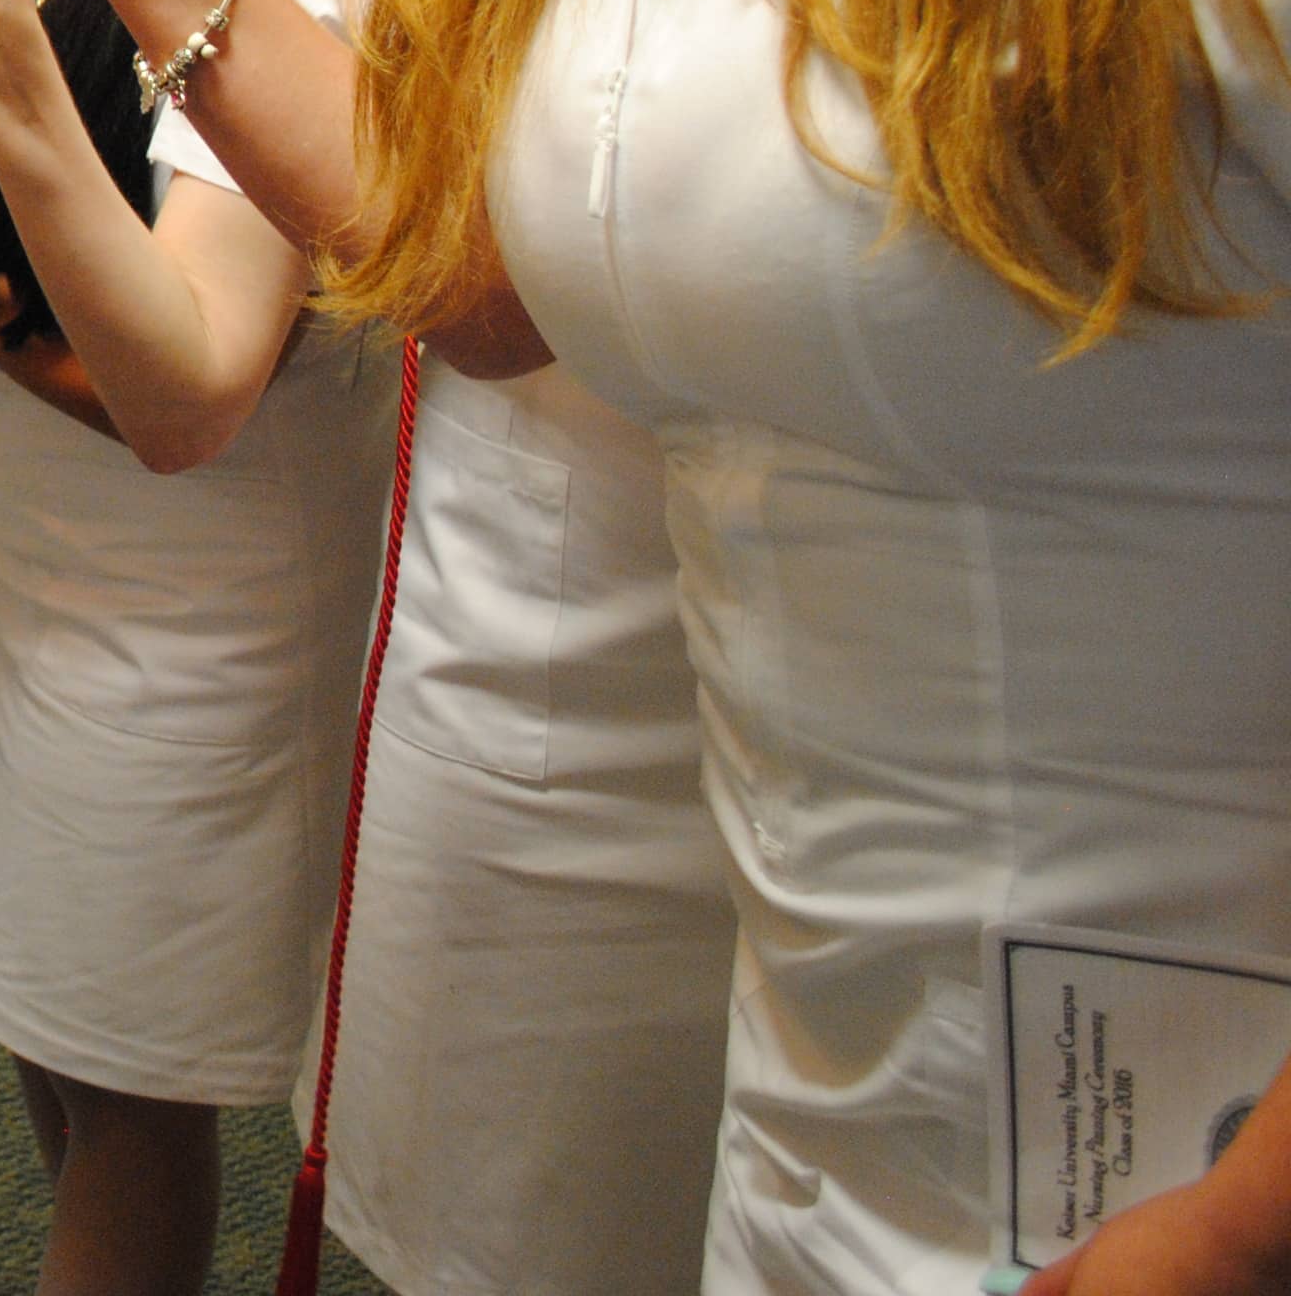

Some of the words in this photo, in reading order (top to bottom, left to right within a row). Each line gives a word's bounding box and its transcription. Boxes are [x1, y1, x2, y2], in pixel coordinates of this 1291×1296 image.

[1055, 985, 1079, 1048] Campus
[1057, 1052, 1076, 1101] Miami
[1084, 1011, 1107, 1091] Ceremony
[1112, 1068, 1133, 1110] 2016
[1057, 1104, 1080, 1186] University
[1085, 1096, 1108, 1156] Pinning
[1114, 1115, 1133, 1130] of
[1112, 1133, 1133, 1176] Class
[1084, 1161, 1108, 1223] Nursing
